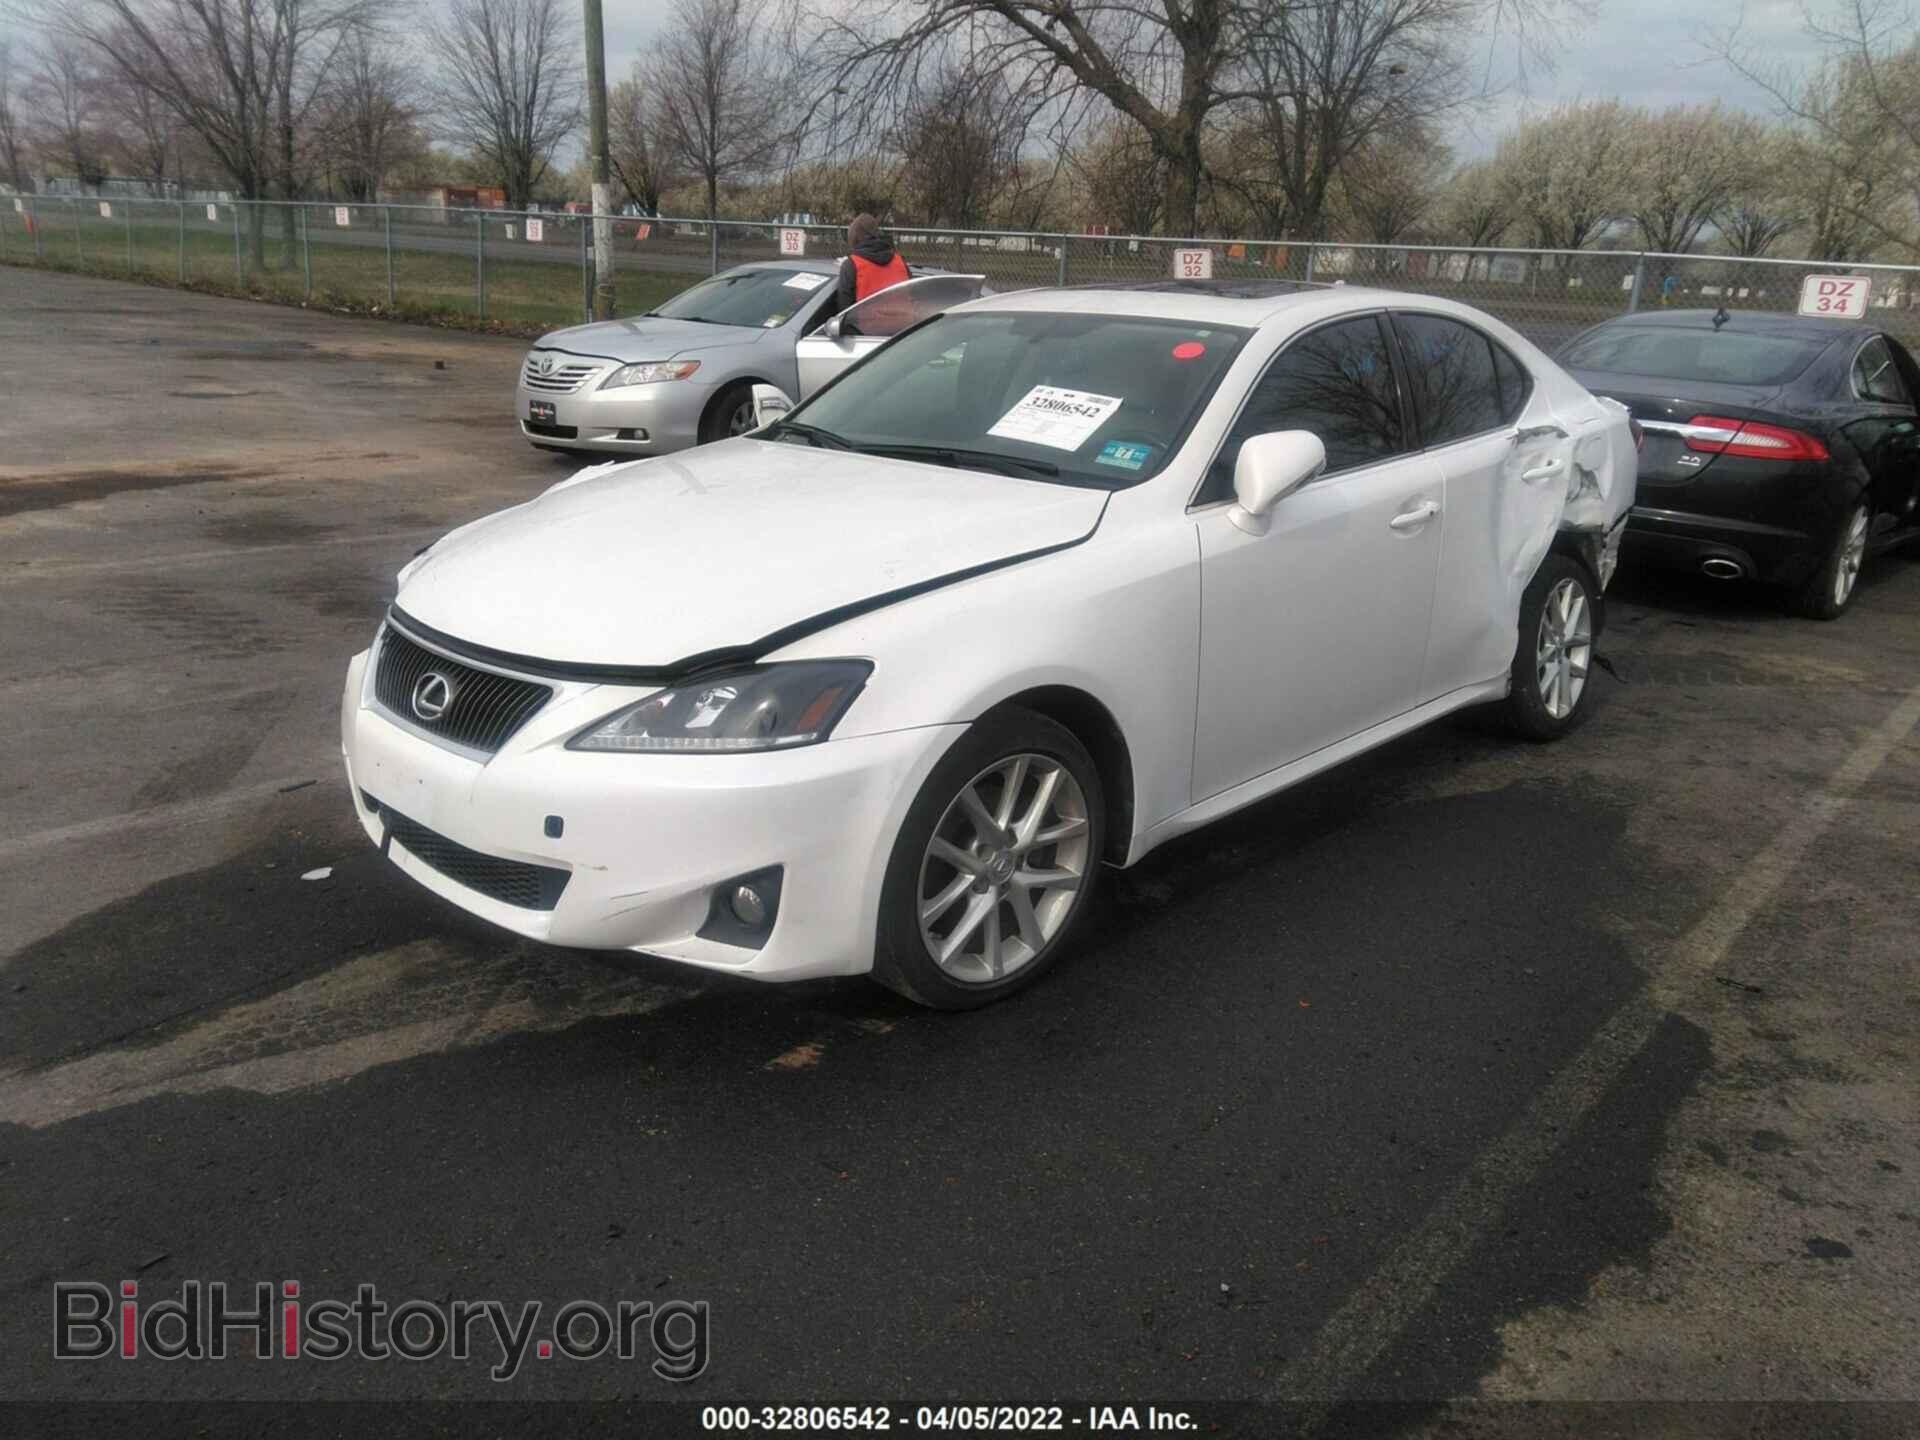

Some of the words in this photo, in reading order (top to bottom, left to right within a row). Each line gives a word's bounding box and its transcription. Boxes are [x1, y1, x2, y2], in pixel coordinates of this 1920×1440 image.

[786, 232, 799, 241] DZ
[1183, 253, 1202, 264] DZ
[1184, 266, 1202, 276] 32
[1818, 281, 1854, 297] DZ
[1816, 298, 1847, 312] 34
[1026, 396, 1100, 418] 32806542
